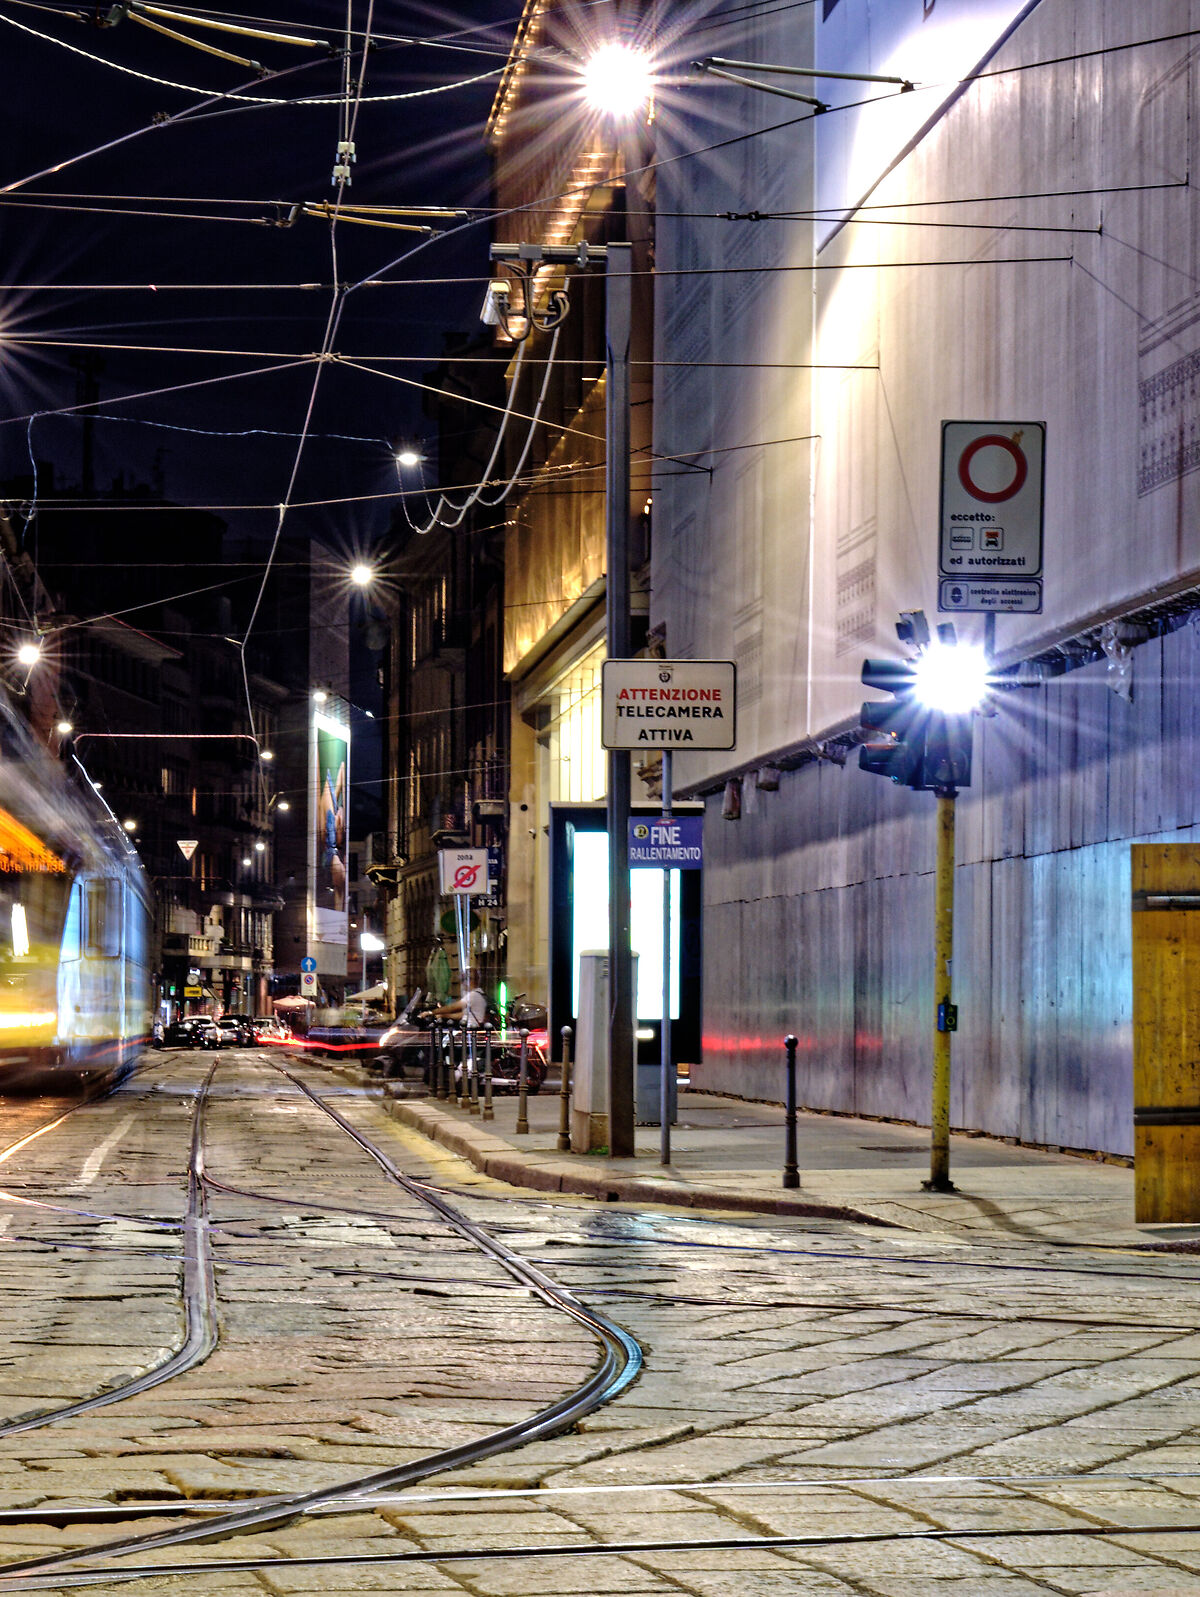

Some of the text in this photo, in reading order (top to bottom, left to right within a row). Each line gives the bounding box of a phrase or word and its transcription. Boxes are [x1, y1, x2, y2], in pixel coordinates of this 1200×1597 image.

[951, 513, 995, 522] eccetto:
[950, 556, 1025, 566] ed autorizzati
[619, 688, 722, 701] ATTENZIONE
[617, 705, 724, 718] TELECAMERA
[638, 729, 693, 741] ATTIVA
[650, 826, 681, 845] FINE
[630, 847, 701, 860] RALLENTAMENTO
